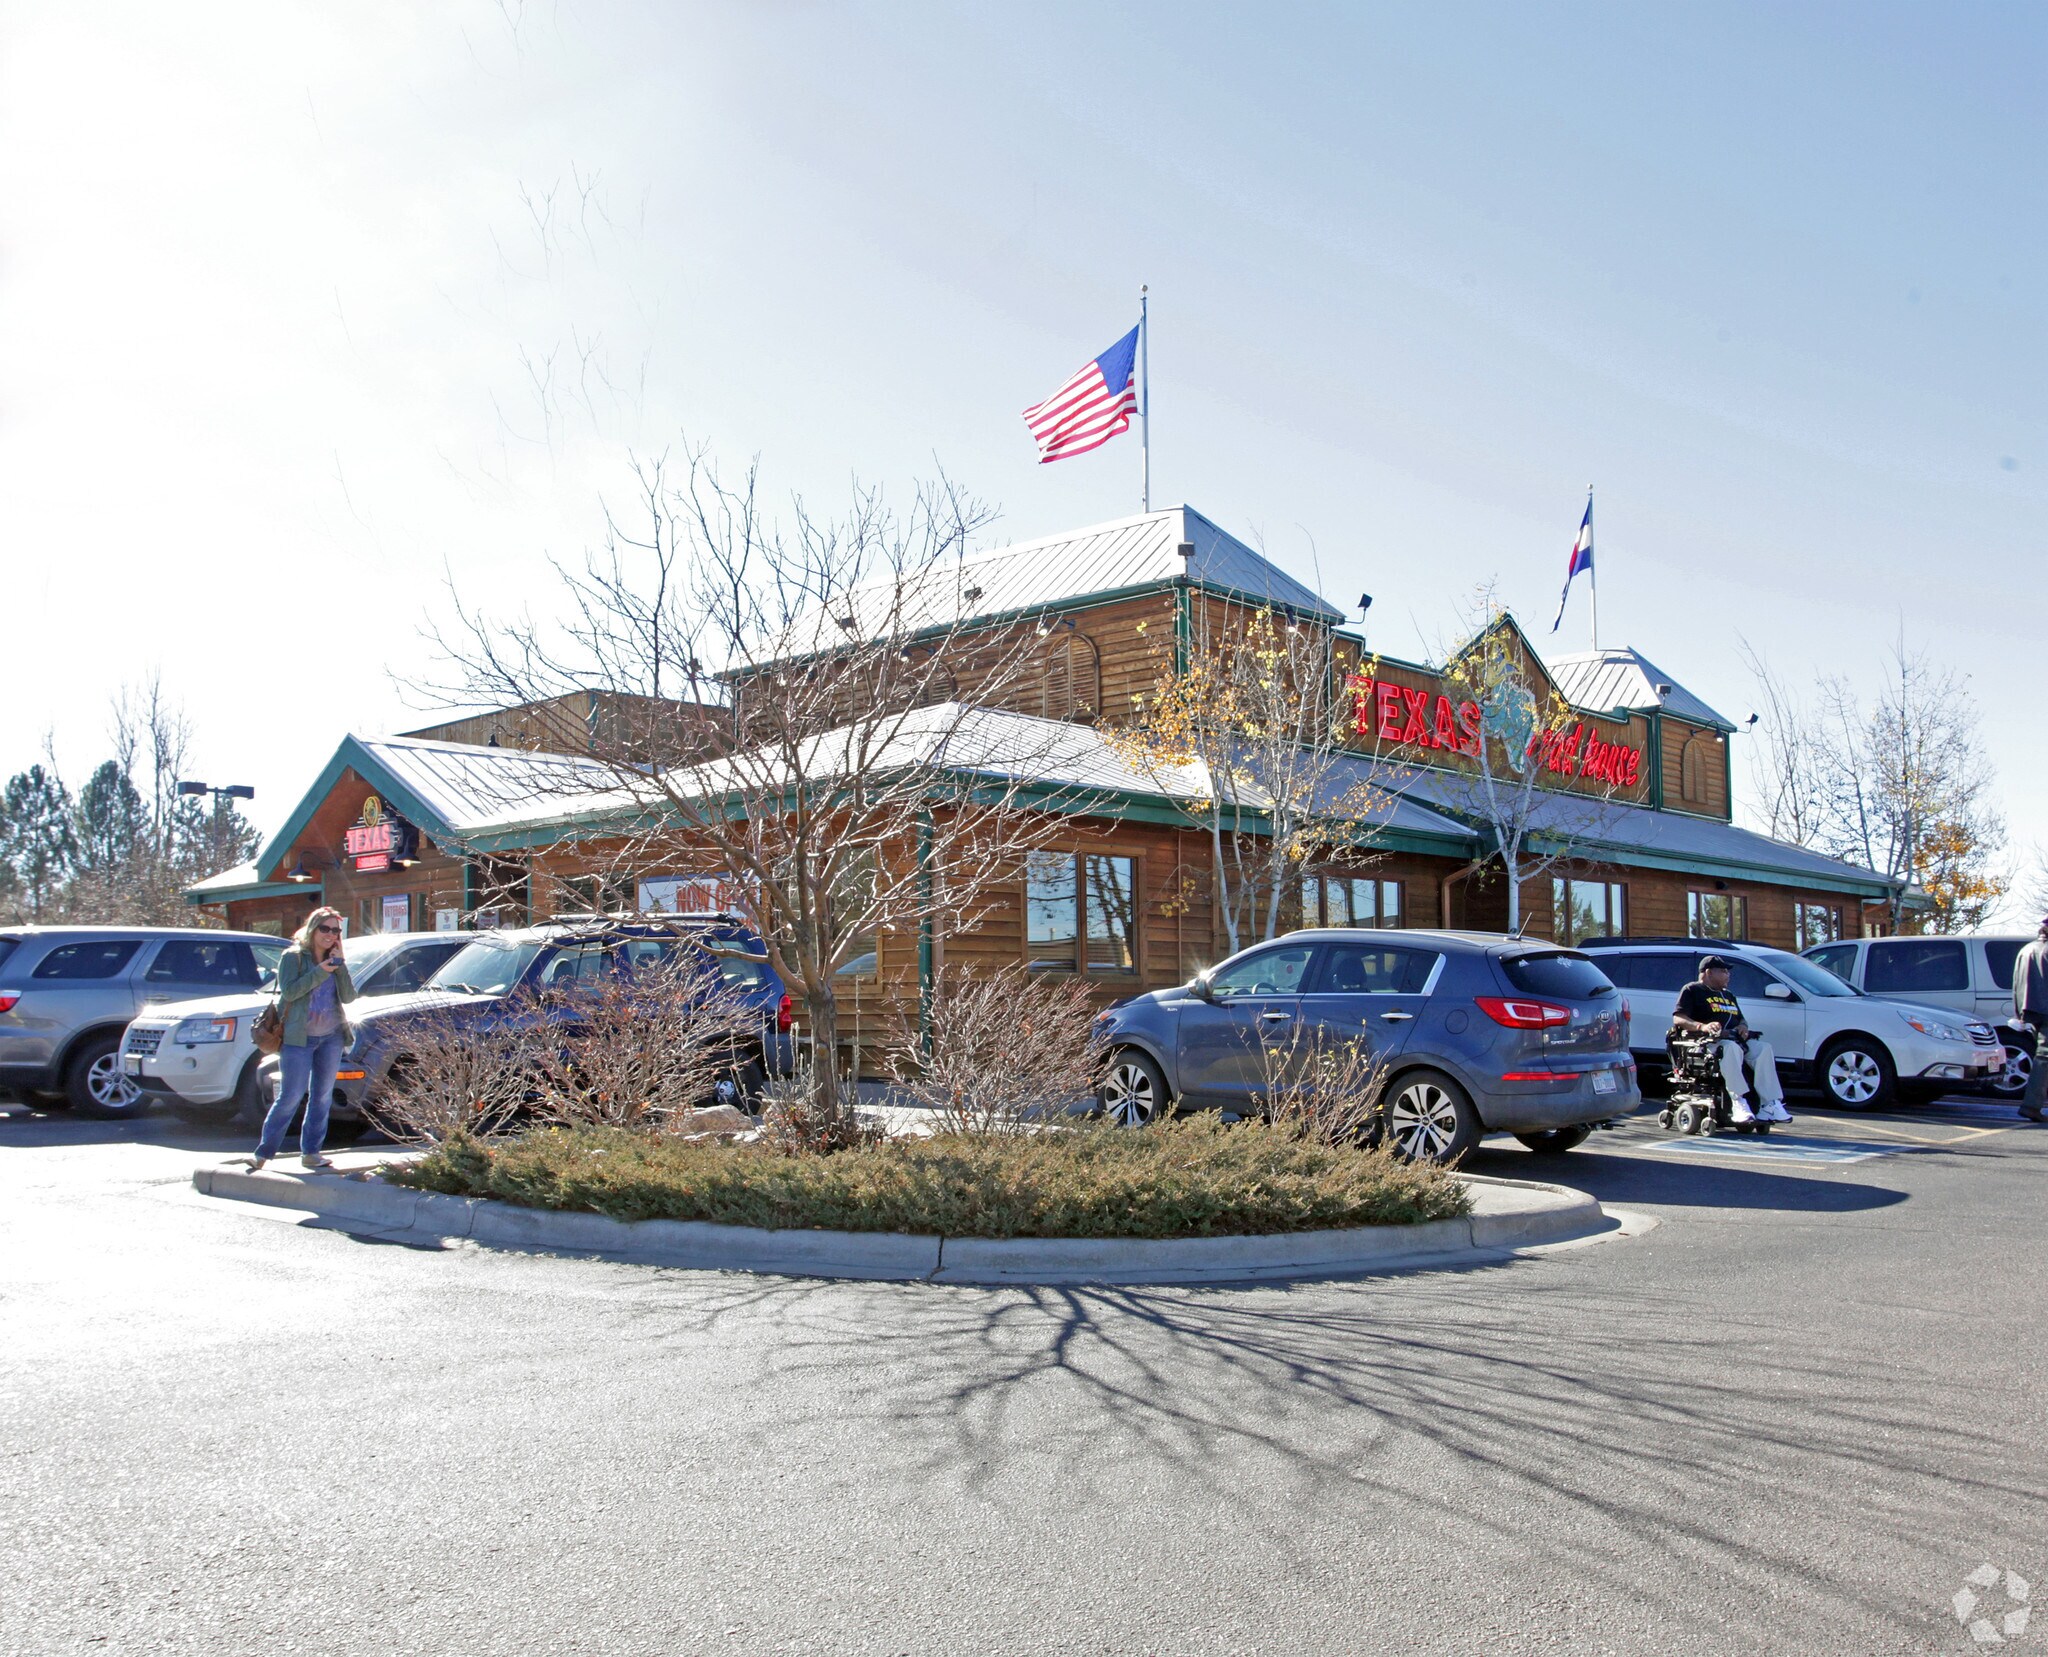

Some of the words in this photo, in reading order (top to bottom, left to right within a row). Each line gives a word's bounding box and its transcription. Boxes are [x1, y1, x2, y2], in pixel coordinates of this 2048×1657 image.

[1346, 674, 1482, 757] TEXAS
[345, 823, 391, 854] TEXAS
[676, 884, 711, 913] NOW
